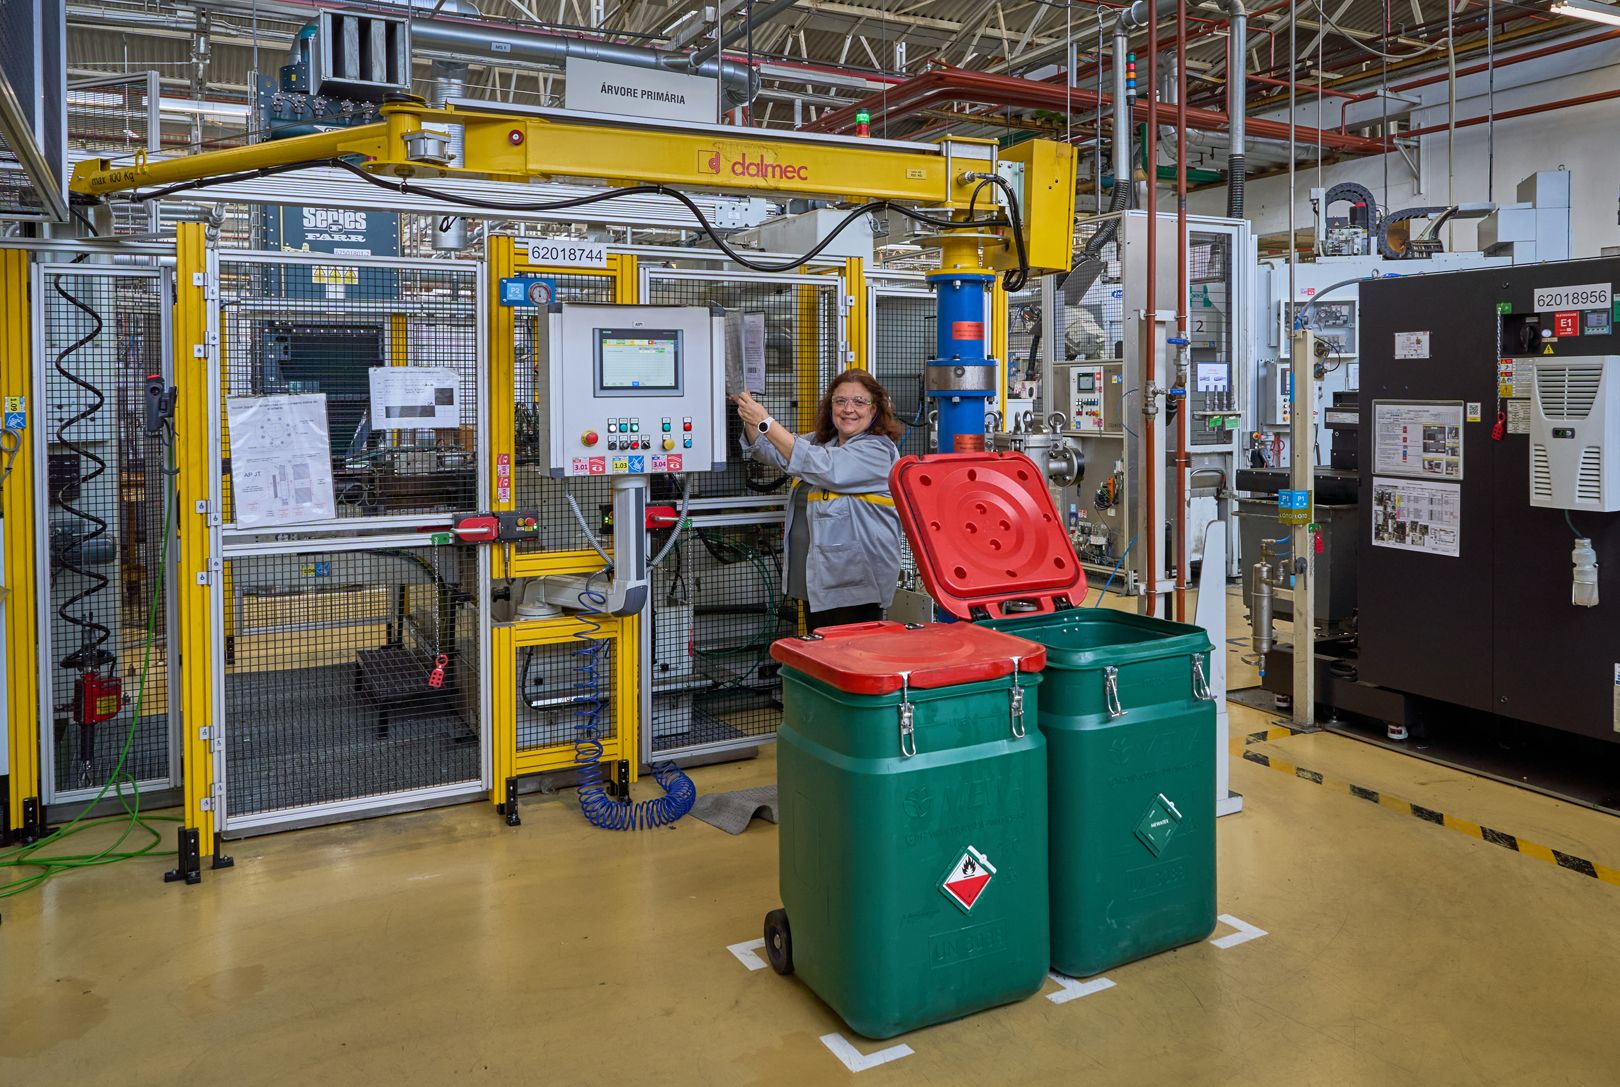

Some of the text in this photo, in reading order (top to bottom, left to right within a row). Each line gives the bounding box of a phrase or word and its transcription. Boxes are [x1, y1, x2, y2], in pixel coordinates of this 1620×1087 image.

[601, 82, 686, 105] ÁRVORE PRIMÁRIA
[731, 152, 808, 181] dalmec
[91, 169, 135, 186] max 100 Kg
[302, 207, 367, 230] Series
[304, 232, 366, 243] FARR
[531, 245, 603, 262] 62018744
[1537, 290, 1607, 307] 62018956
[1195, 320, 1204, 332] 2
[1560, 318, 1572, 327] E1
[10, 398, 18, 412] 1.09
